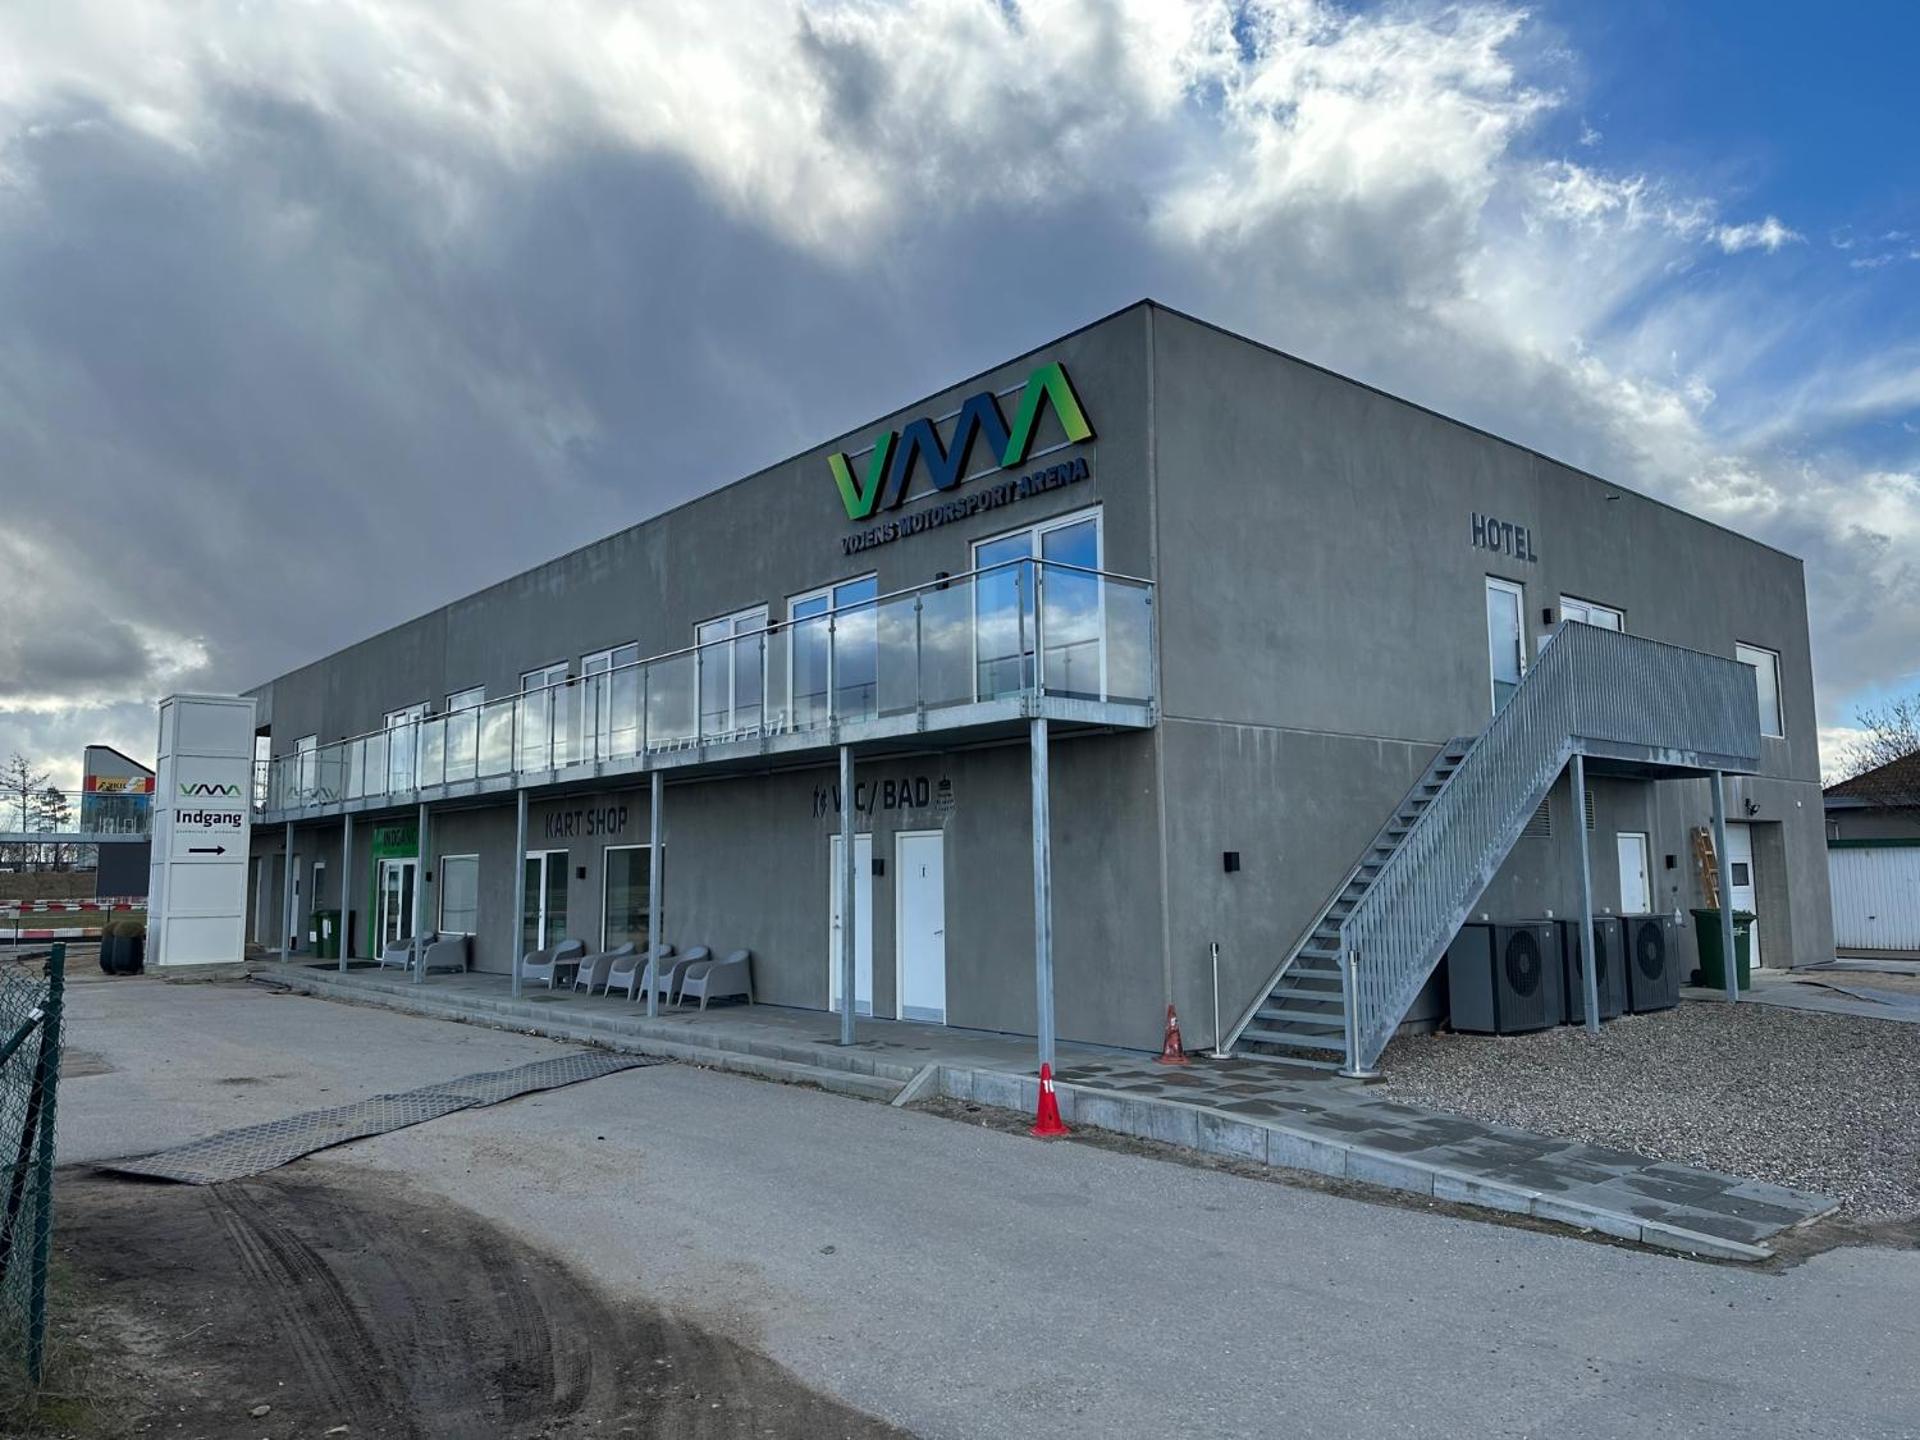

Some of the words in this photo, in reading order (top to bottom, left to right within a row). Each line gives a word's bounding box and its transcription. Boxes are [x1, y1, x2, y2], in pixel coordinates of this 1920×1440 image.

[840, 520, 899, 556] VOJENS
[900, 480, 1018, 538] MOTORSPORT
[1017, 457, 1090, 498] ARENA
[1470, 511, 1538, 563] HOTEL
[883, 776, 930, 810] BAD
[176, 809, 242, 828] Indgang
[545, 810, 582, 839] KART
[587, 806, 628, 836] SHOP
